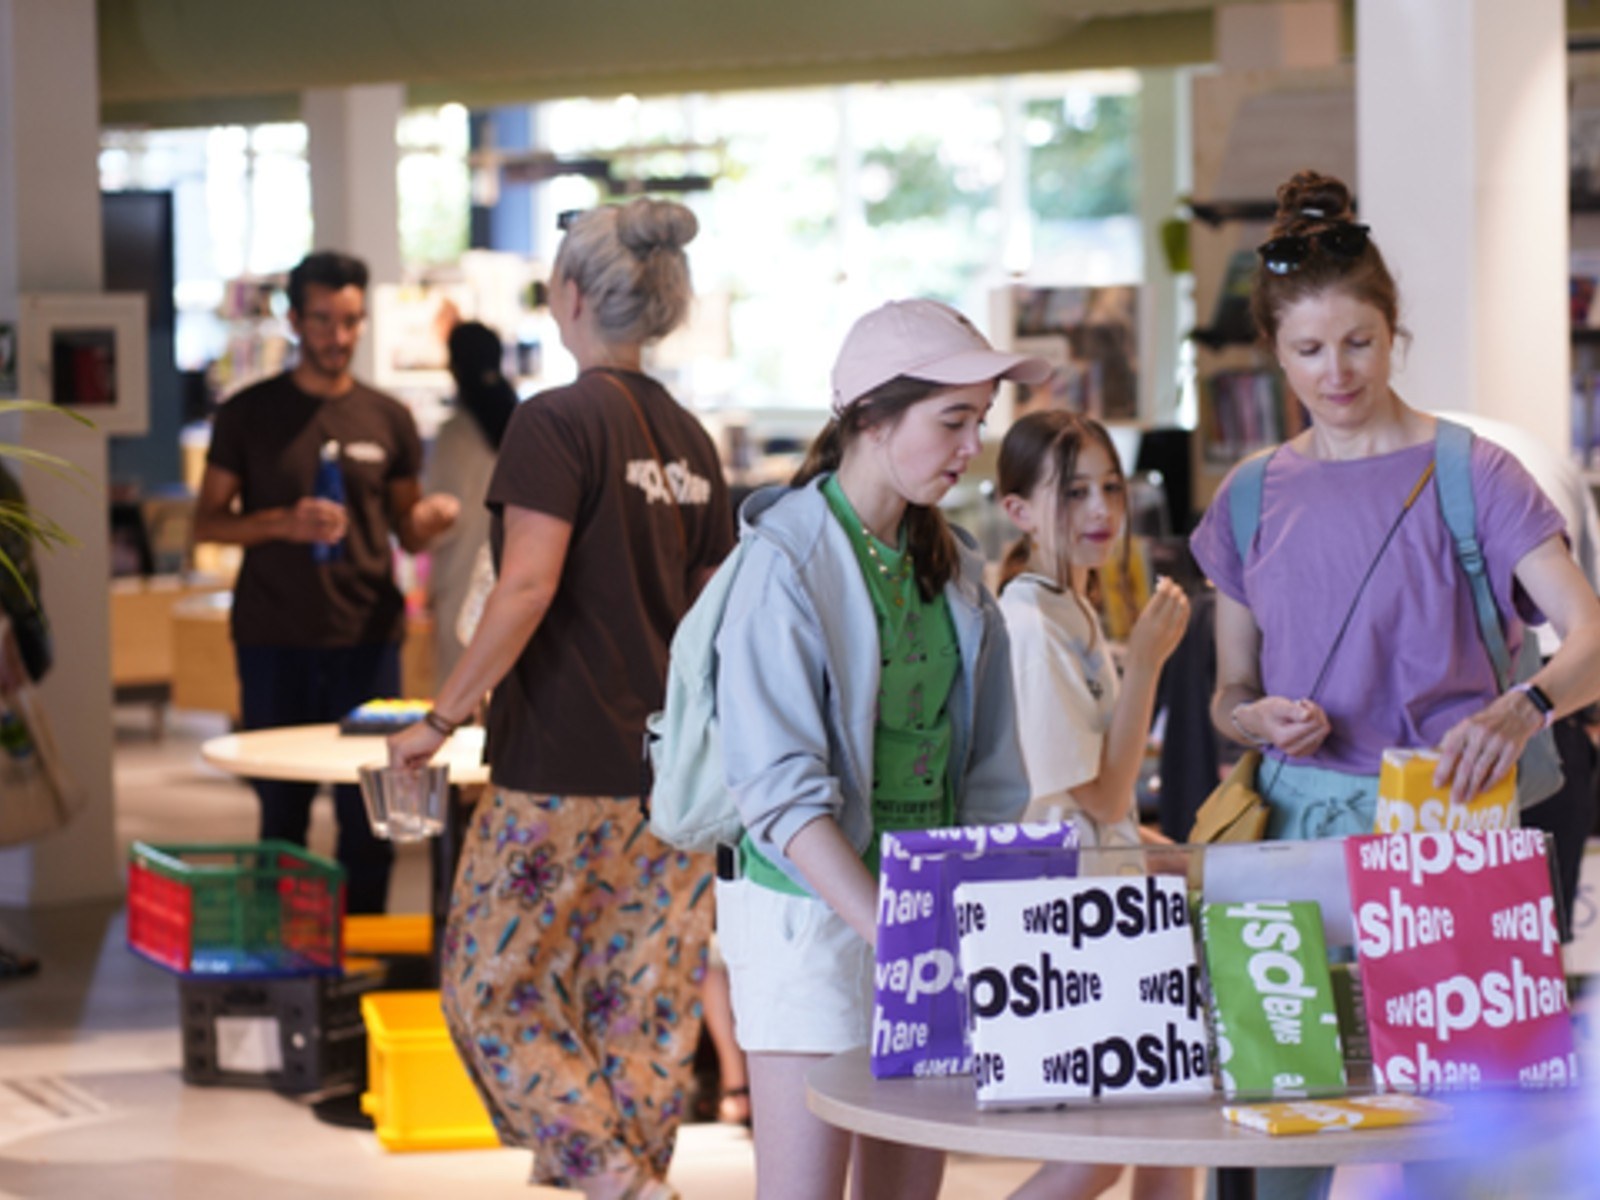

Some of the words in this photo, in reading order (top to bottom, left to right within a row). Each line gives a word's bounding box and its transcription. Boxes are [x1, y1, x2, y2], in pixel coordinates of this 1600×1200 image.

[877, 872, 934, 927] hare
[969, 953, 1101, 1031] pshare
[873, 1004, 928, 1056] hare
